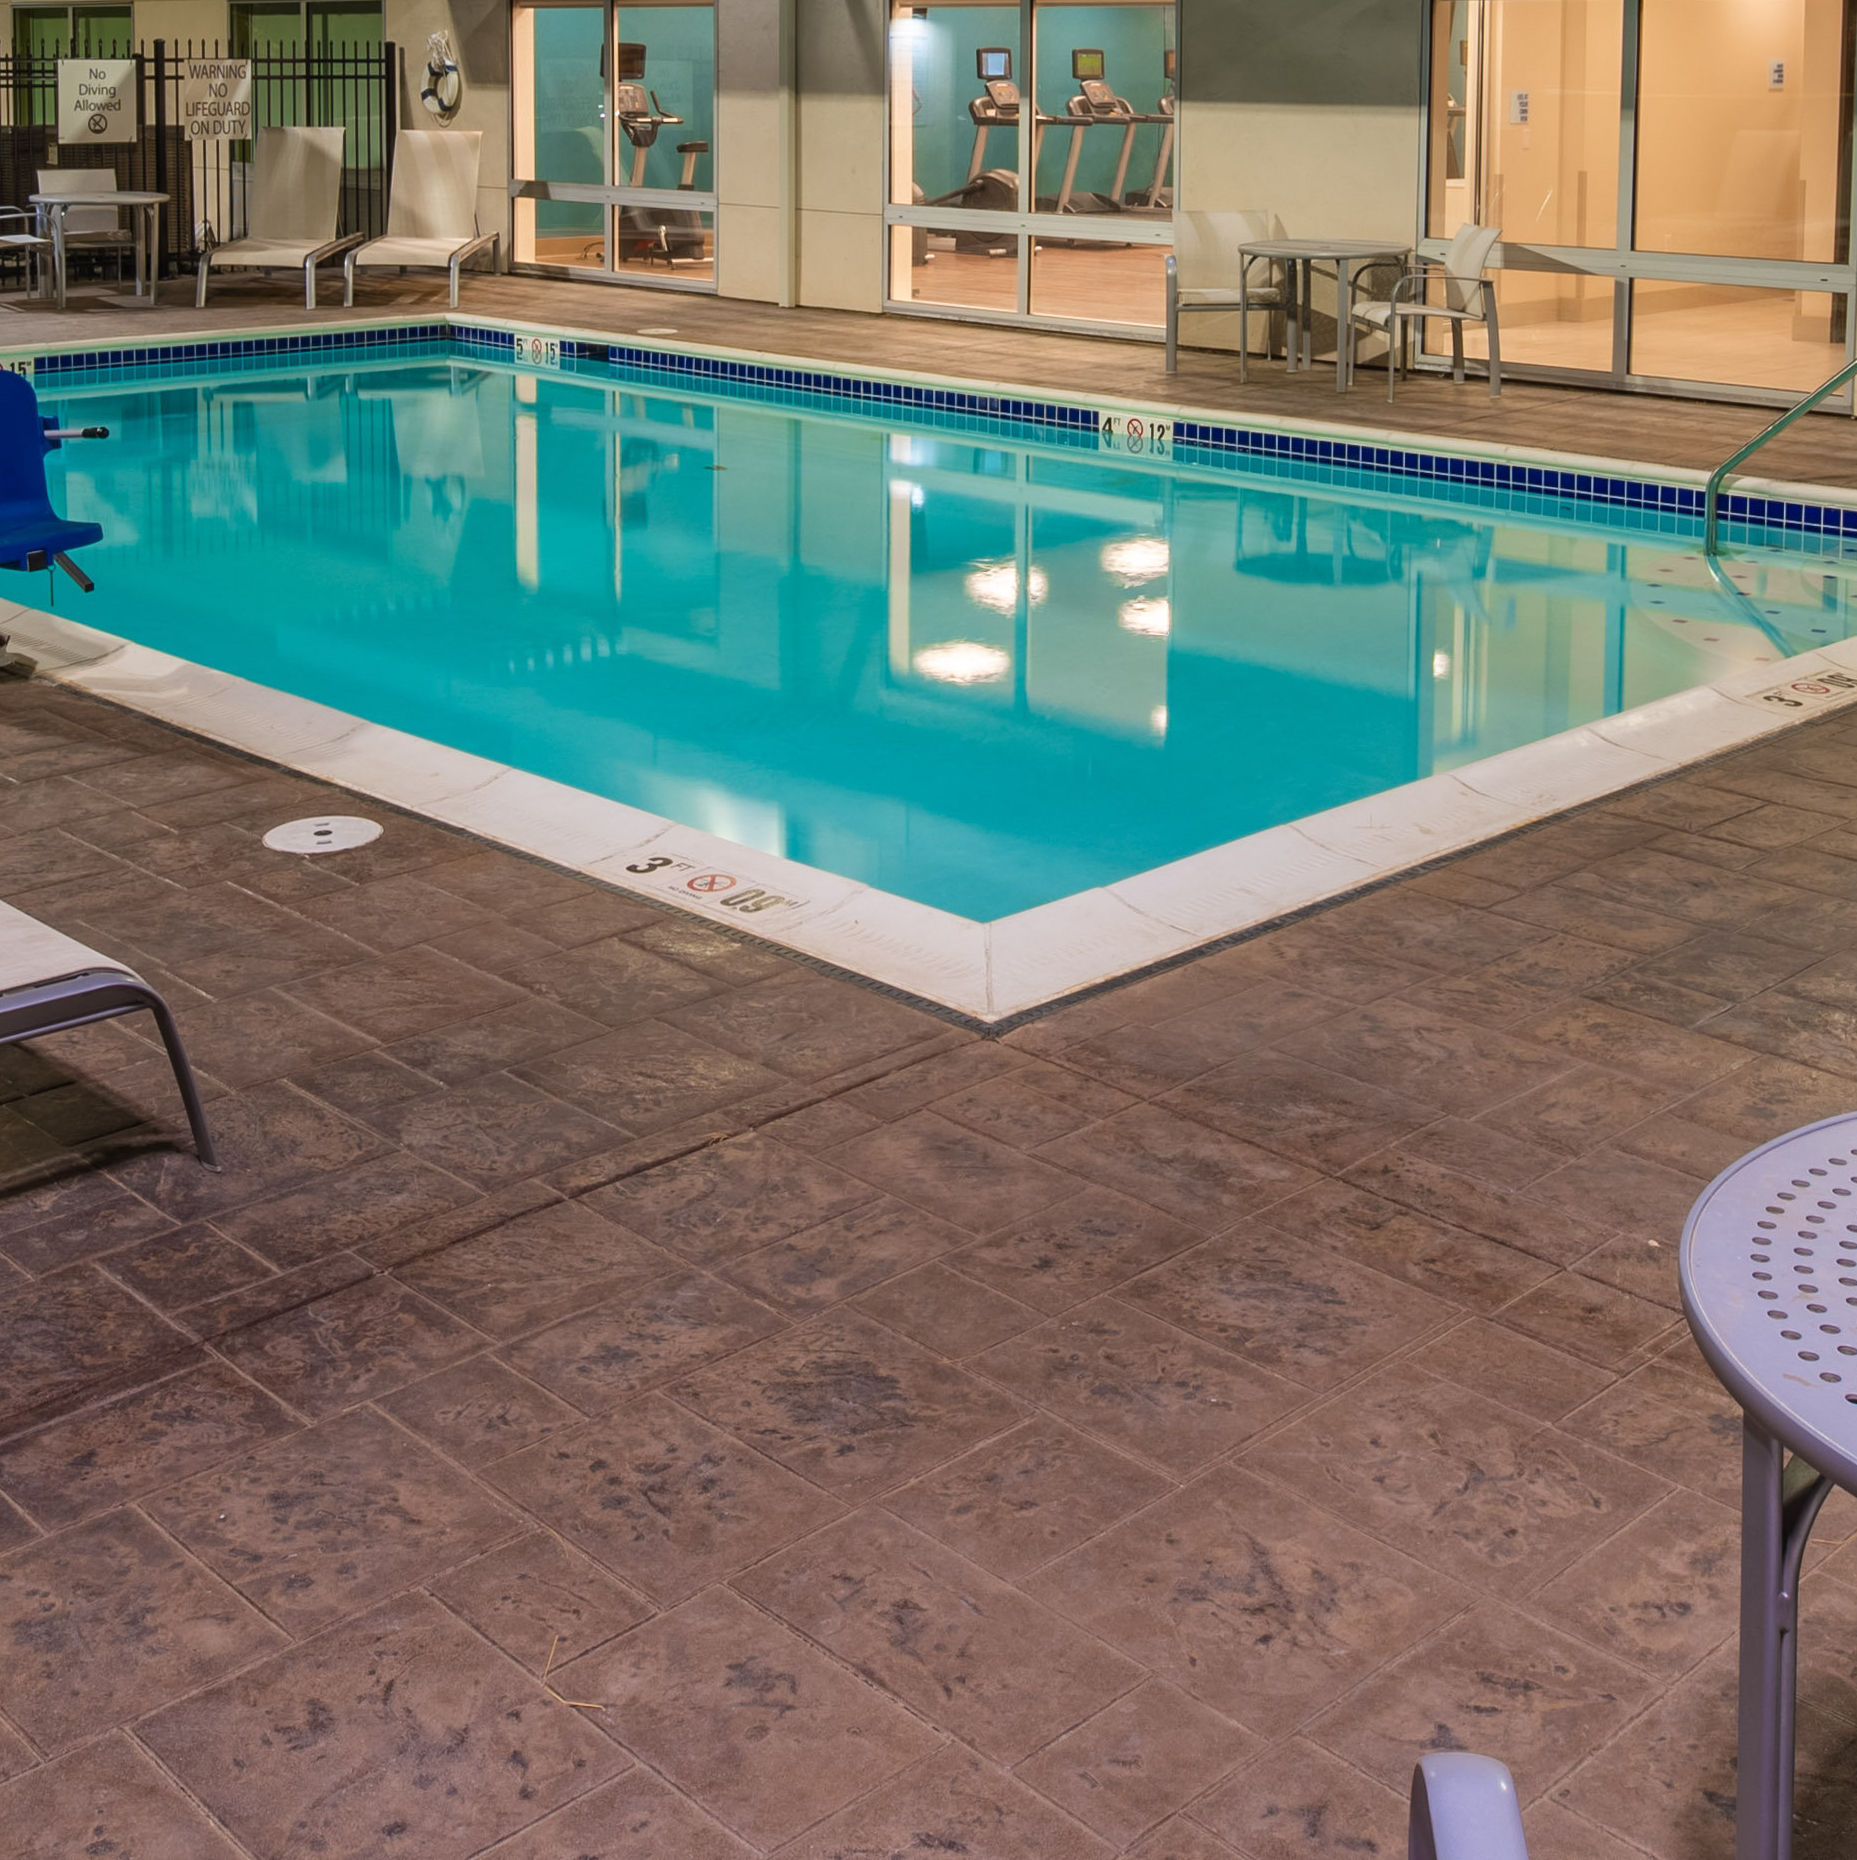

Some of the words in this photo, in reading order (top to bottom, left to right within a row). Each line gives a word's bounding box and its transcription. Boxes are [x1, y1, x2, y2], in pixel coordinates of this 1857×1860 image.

[89, 68, 107, 80] No
[189, 64, 247, 79] WARNING
[78, 83, 117, 99] Diving
[208, 82, 229, 98] NO
[73, 99, 122, 112] Allowed
[185, 101, 252, 117] LIFEGUARD
[190, 120, 210, 136] ON
[213, 120, 246, 136] DUTY
[1102, 417, 1113, 433] 4
[1113, 417, 1121, 426] FT
[626, 857, 673, 874] 3
[672, 862, 696, 872] FT
